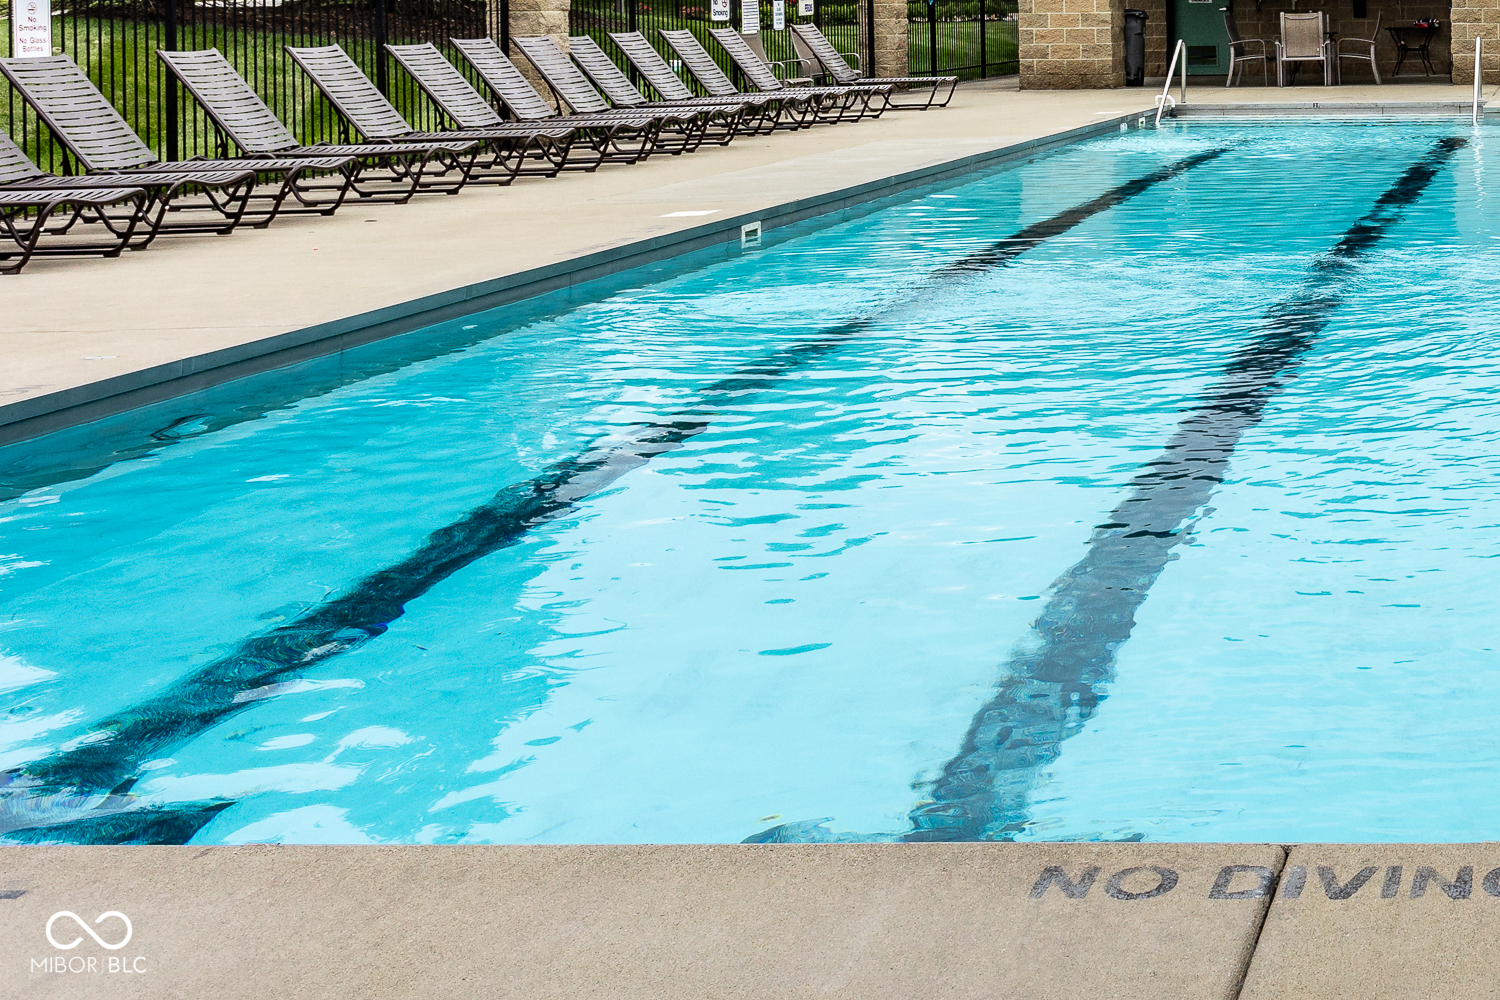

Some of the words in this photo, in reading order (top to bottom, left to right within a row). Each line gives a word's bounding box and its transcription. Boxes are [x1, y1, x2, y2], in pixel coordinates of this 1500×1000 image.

[18, 24, 47, 32] Smoking
[30, 36, 47, 44] Glass
[22, 45, 44, 53] Bottles
[1028, 864, 1179, 901] NO
